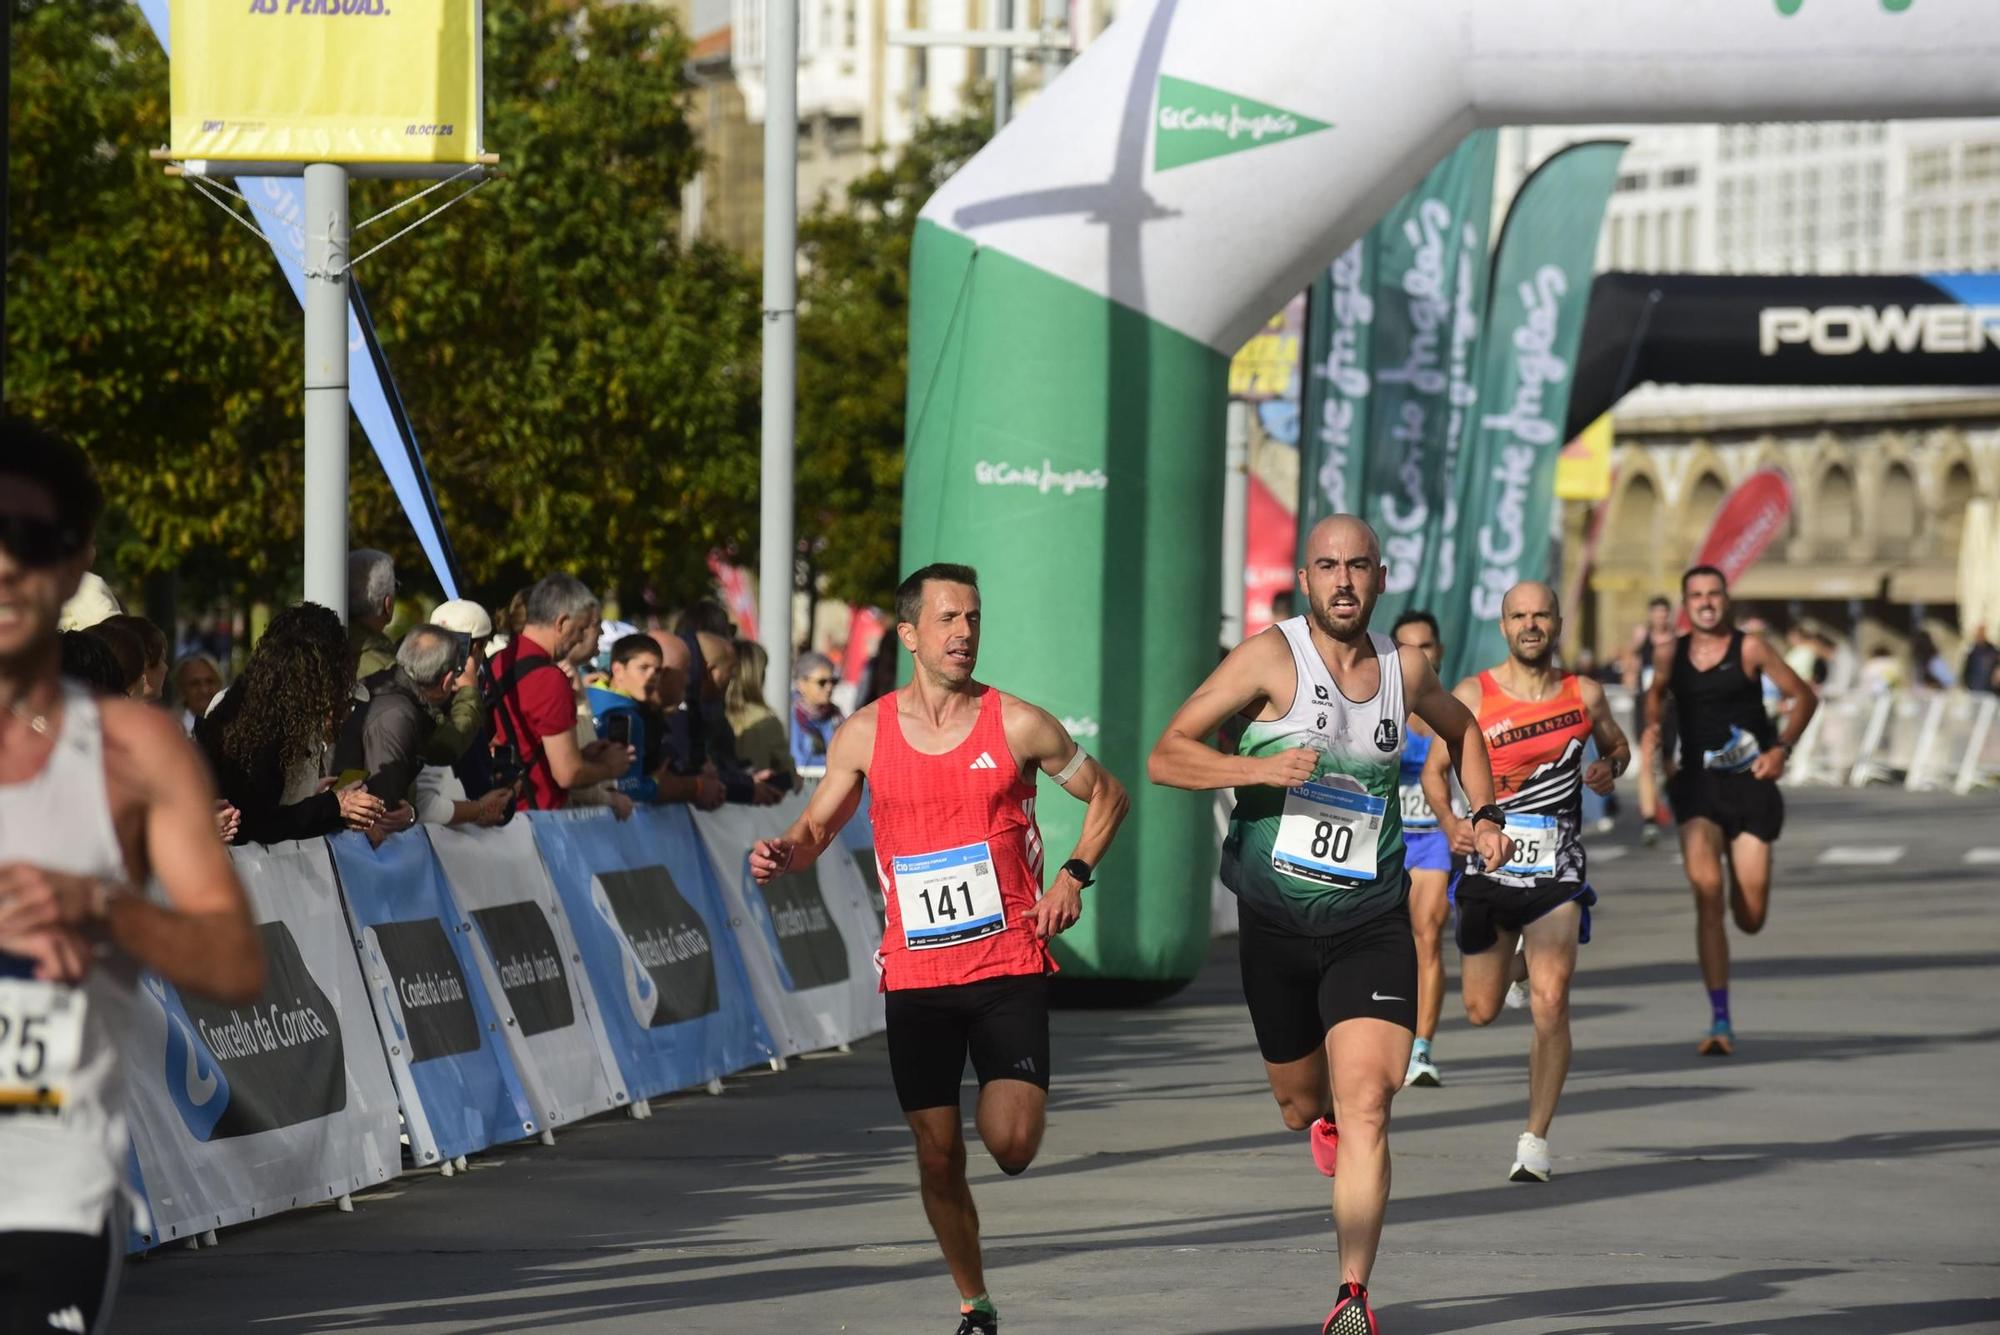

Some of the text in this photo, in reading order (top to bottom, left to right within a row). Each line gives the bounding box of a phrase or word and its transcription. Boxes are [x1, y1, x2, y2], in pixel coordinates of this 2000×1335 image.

[1376, 198, 1450, 394] Inglés
[1480, 265, 1568, 444] Inglés
[1311, 821, 1353, 863] 80
[919, 881, 974, 924] 141
[199, 1009, 259, 1060] Concello
[254, 1005, 278, 1050] da
